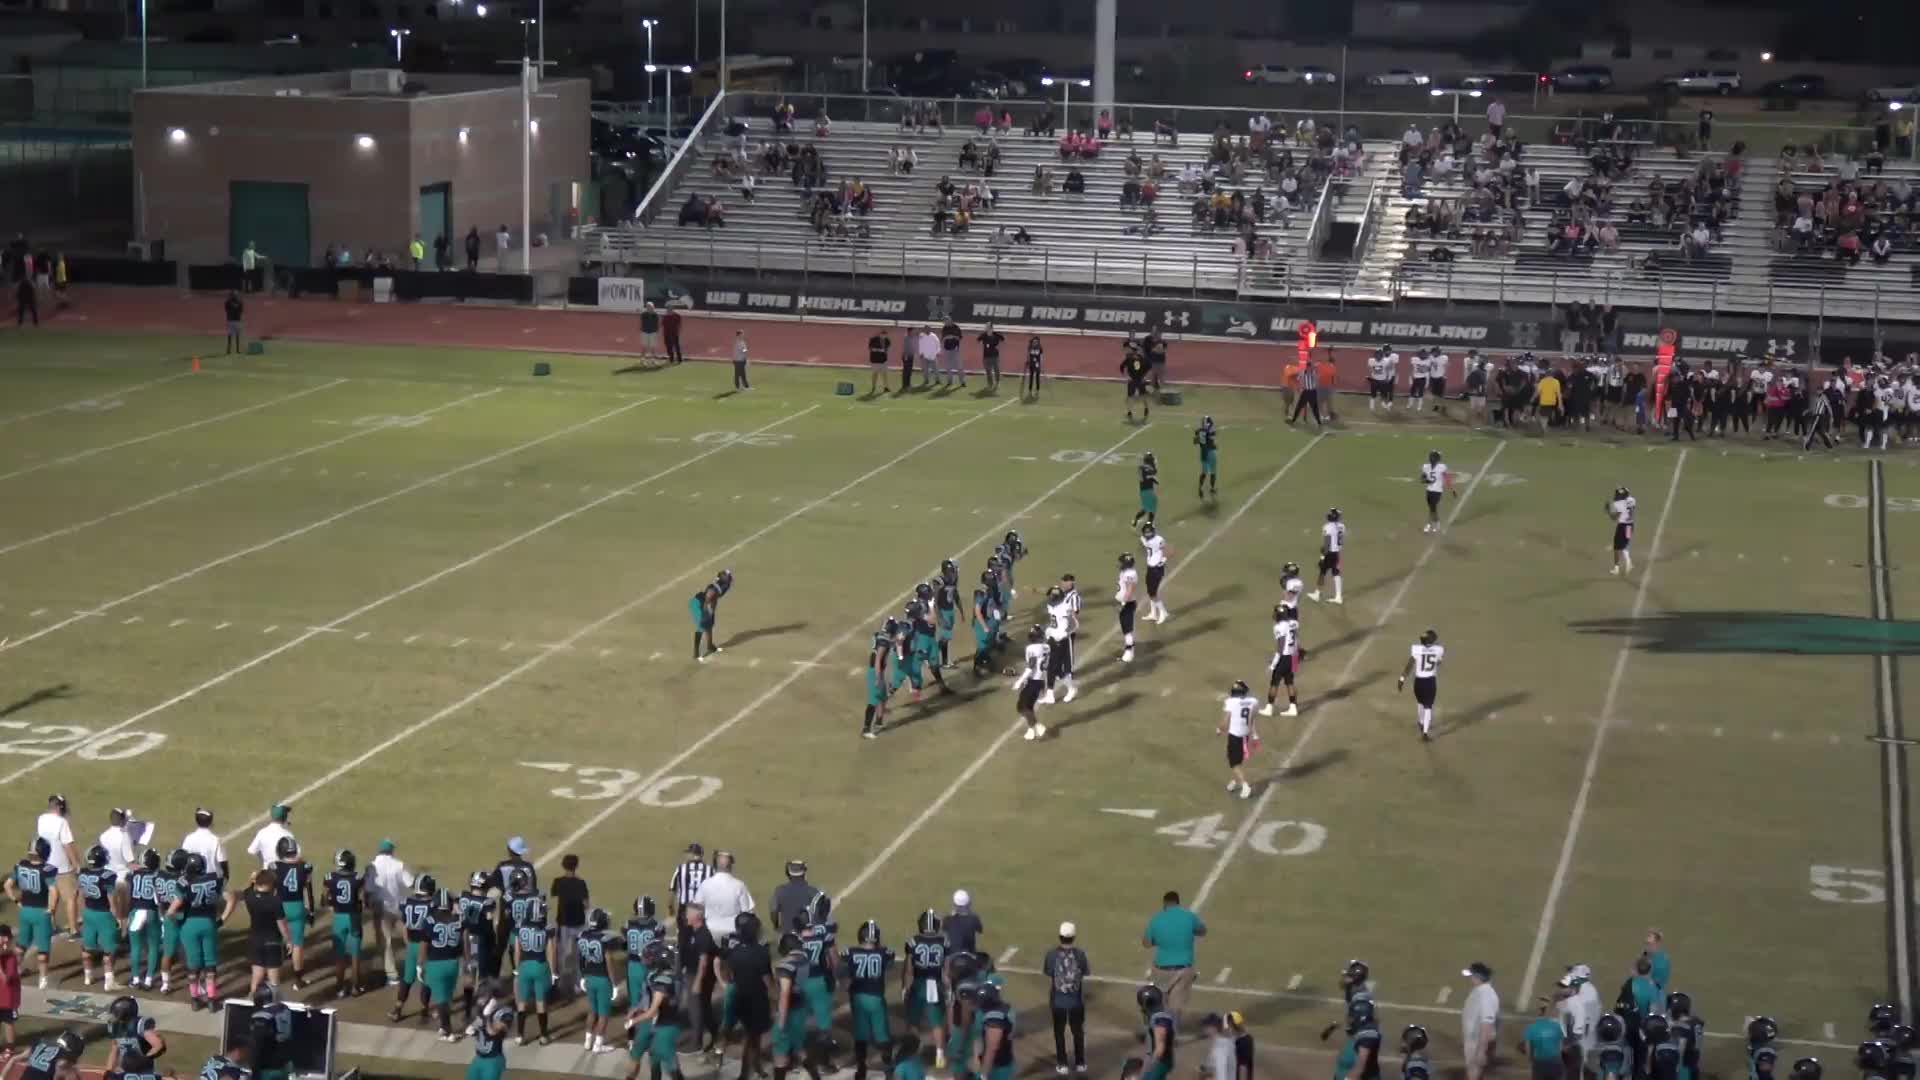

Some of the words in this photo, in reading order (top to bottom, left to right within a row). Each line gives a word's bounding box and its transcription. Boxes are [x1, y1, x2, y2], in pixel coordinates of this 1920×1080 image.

[706, 291, 741, 305] WE
[747, 293, 791, 308] ARE
[798, 296, 906, 312] HIGHLAND
[973, 304, 1024, 318] RISE
[1031, 306, 1078, 320] AND
[1085, 309, 1146, 323] SOAR
[1316, 320, 1363, 334] ARE
[1371, 322, 1488, 339] HIGHLAND
[1682, 336, 1749, 352] SOAR
[1419, 653, 1436, 672] 15
[1240, 706, 1250, 726] 9
[551, 767, 723, 807] 30
[1155, 813, 1329, 855] 40
[132, 875, 156, 900] 16
[283, 867, 298, 892] 4
[336, 879, 352, 904] 3
[190, 880, 219, 907] 75
[404, 903, 429, 930] 17
[432, 921, 461, 949] 35
[519, 927, 547, 953] 90
[852, 952, 884, 979] 70
[915, 943, 945, 967] 33
